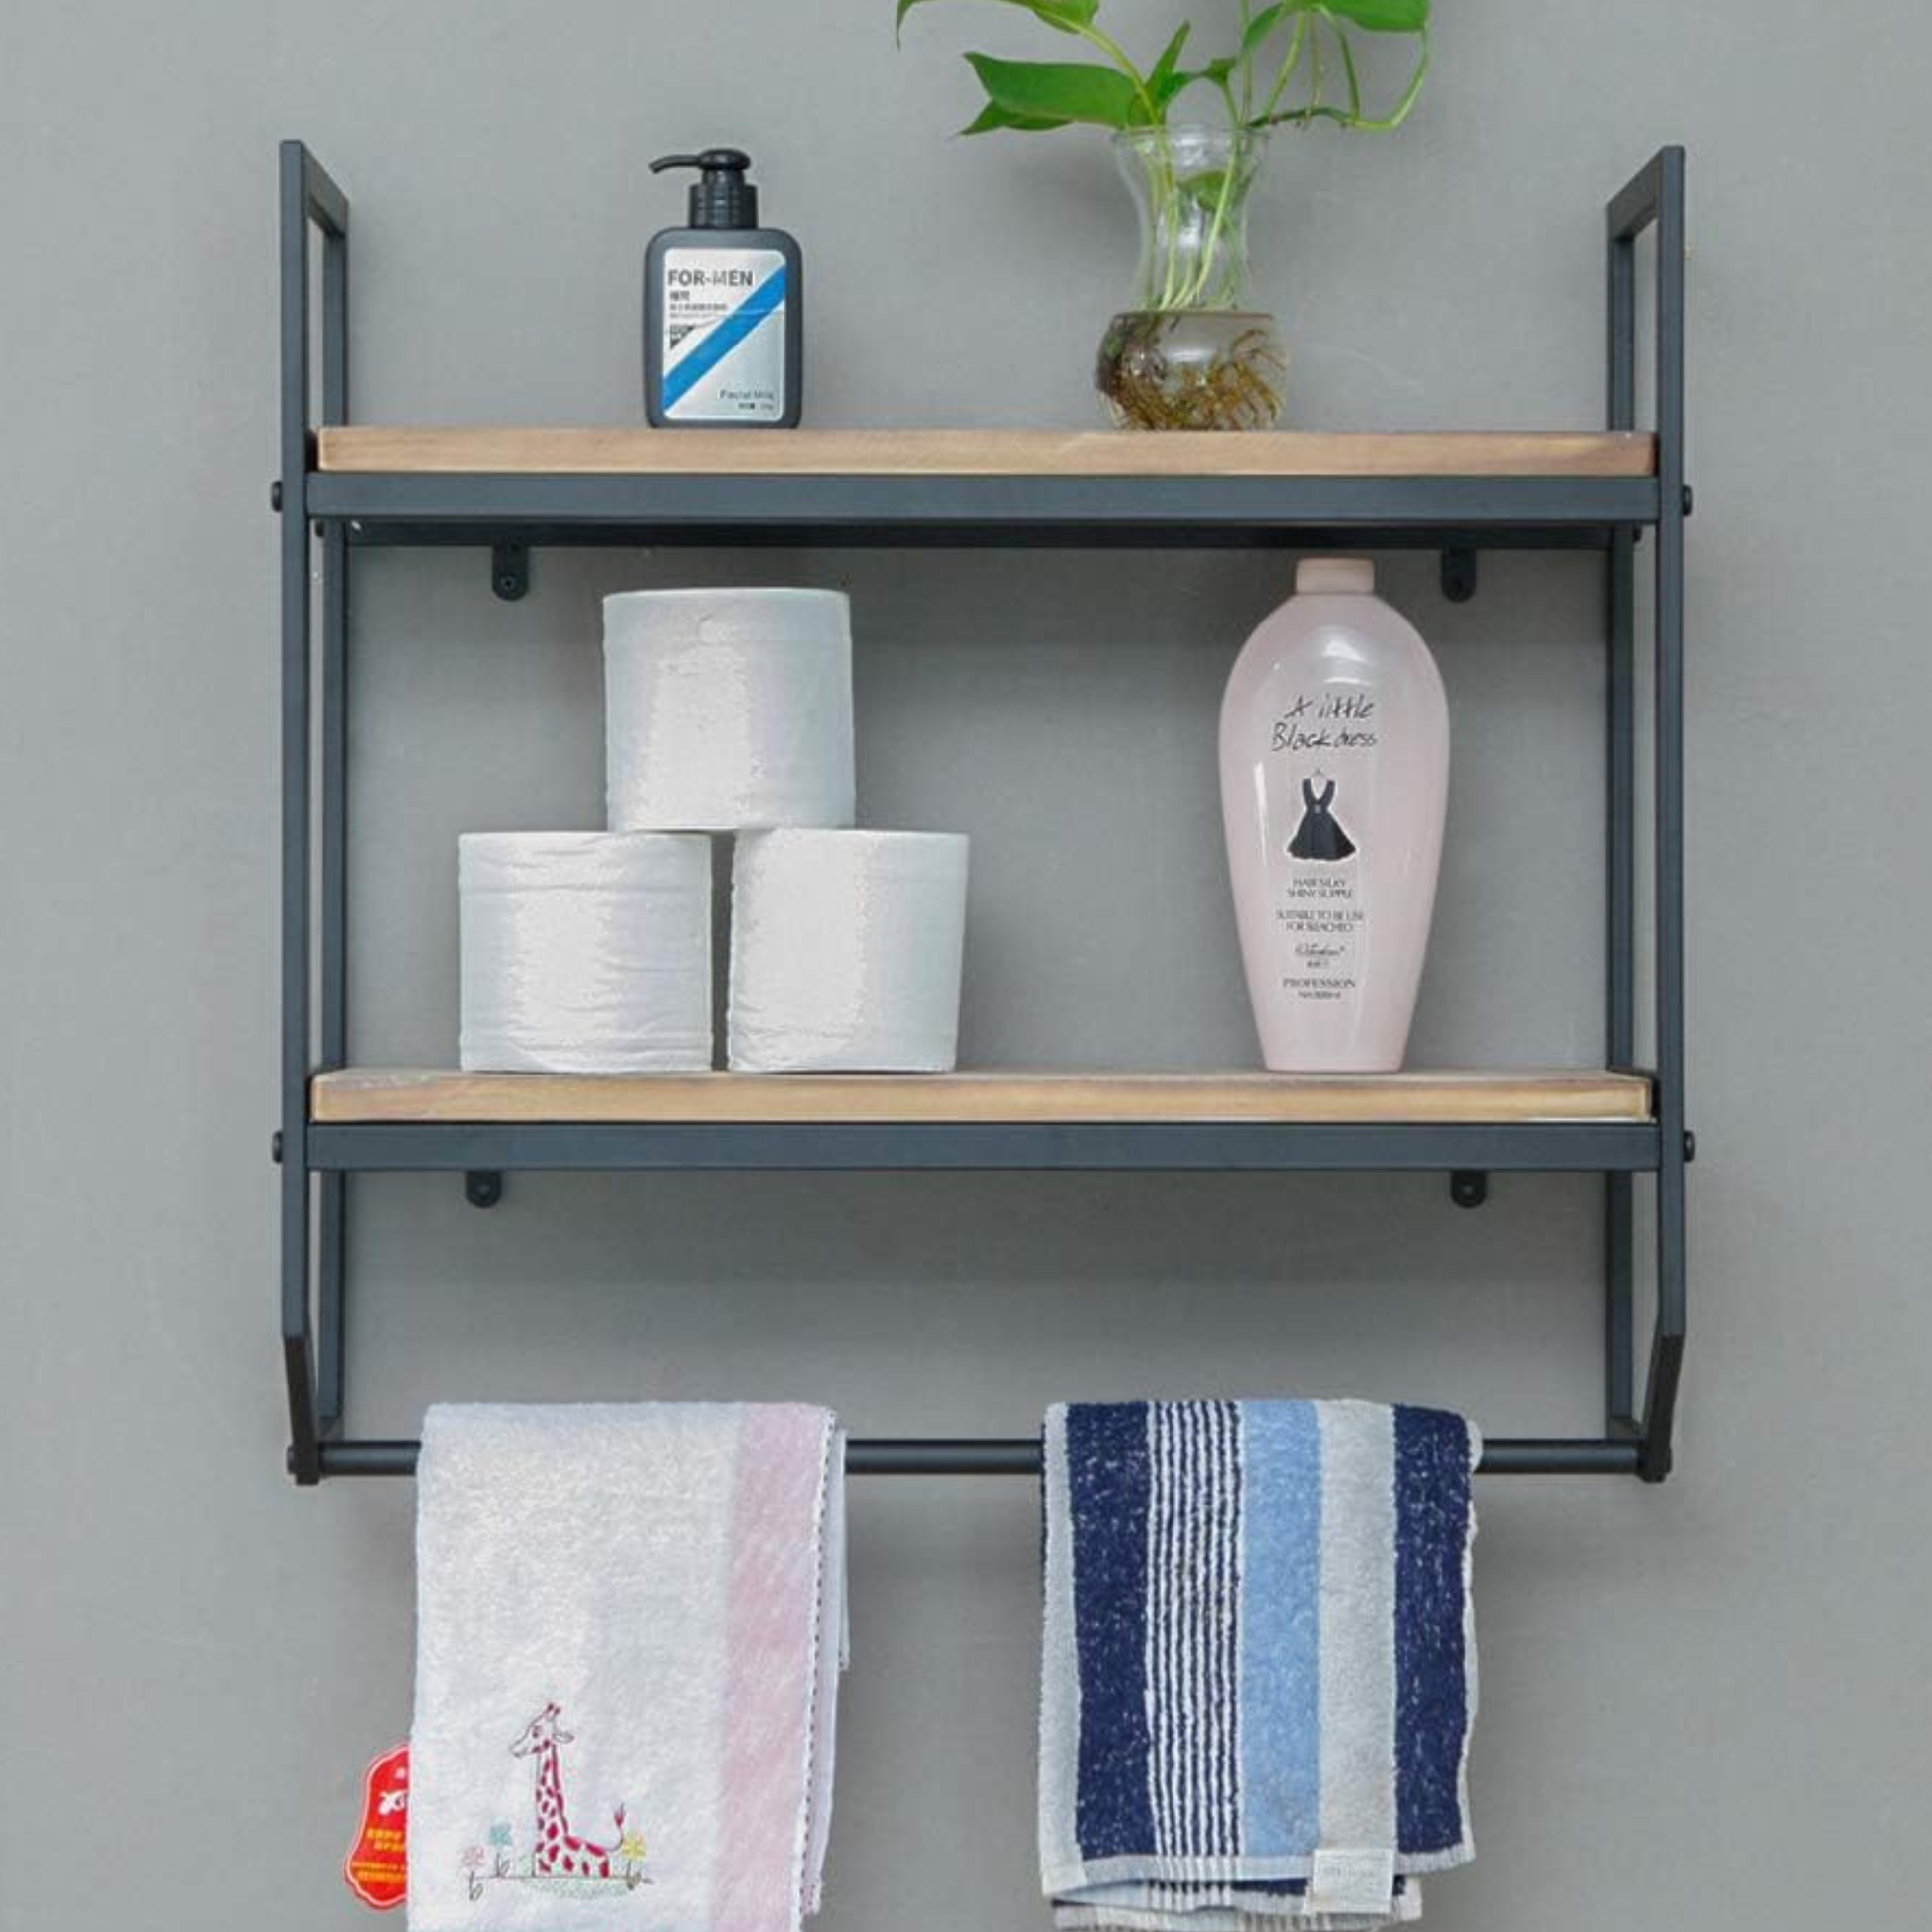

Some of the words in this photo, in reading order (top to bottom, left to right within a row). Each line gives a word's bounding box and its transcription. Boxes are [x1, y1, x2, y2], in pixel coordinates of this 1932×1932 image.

[667, 269, 753, 287] FOR-MEN
[1284, 694, 1313, 719] A
[1318, 693, 1374, 719] little
[1271, 722, 1331, 752] Black
[1333, 727, 1378, 748] dress
